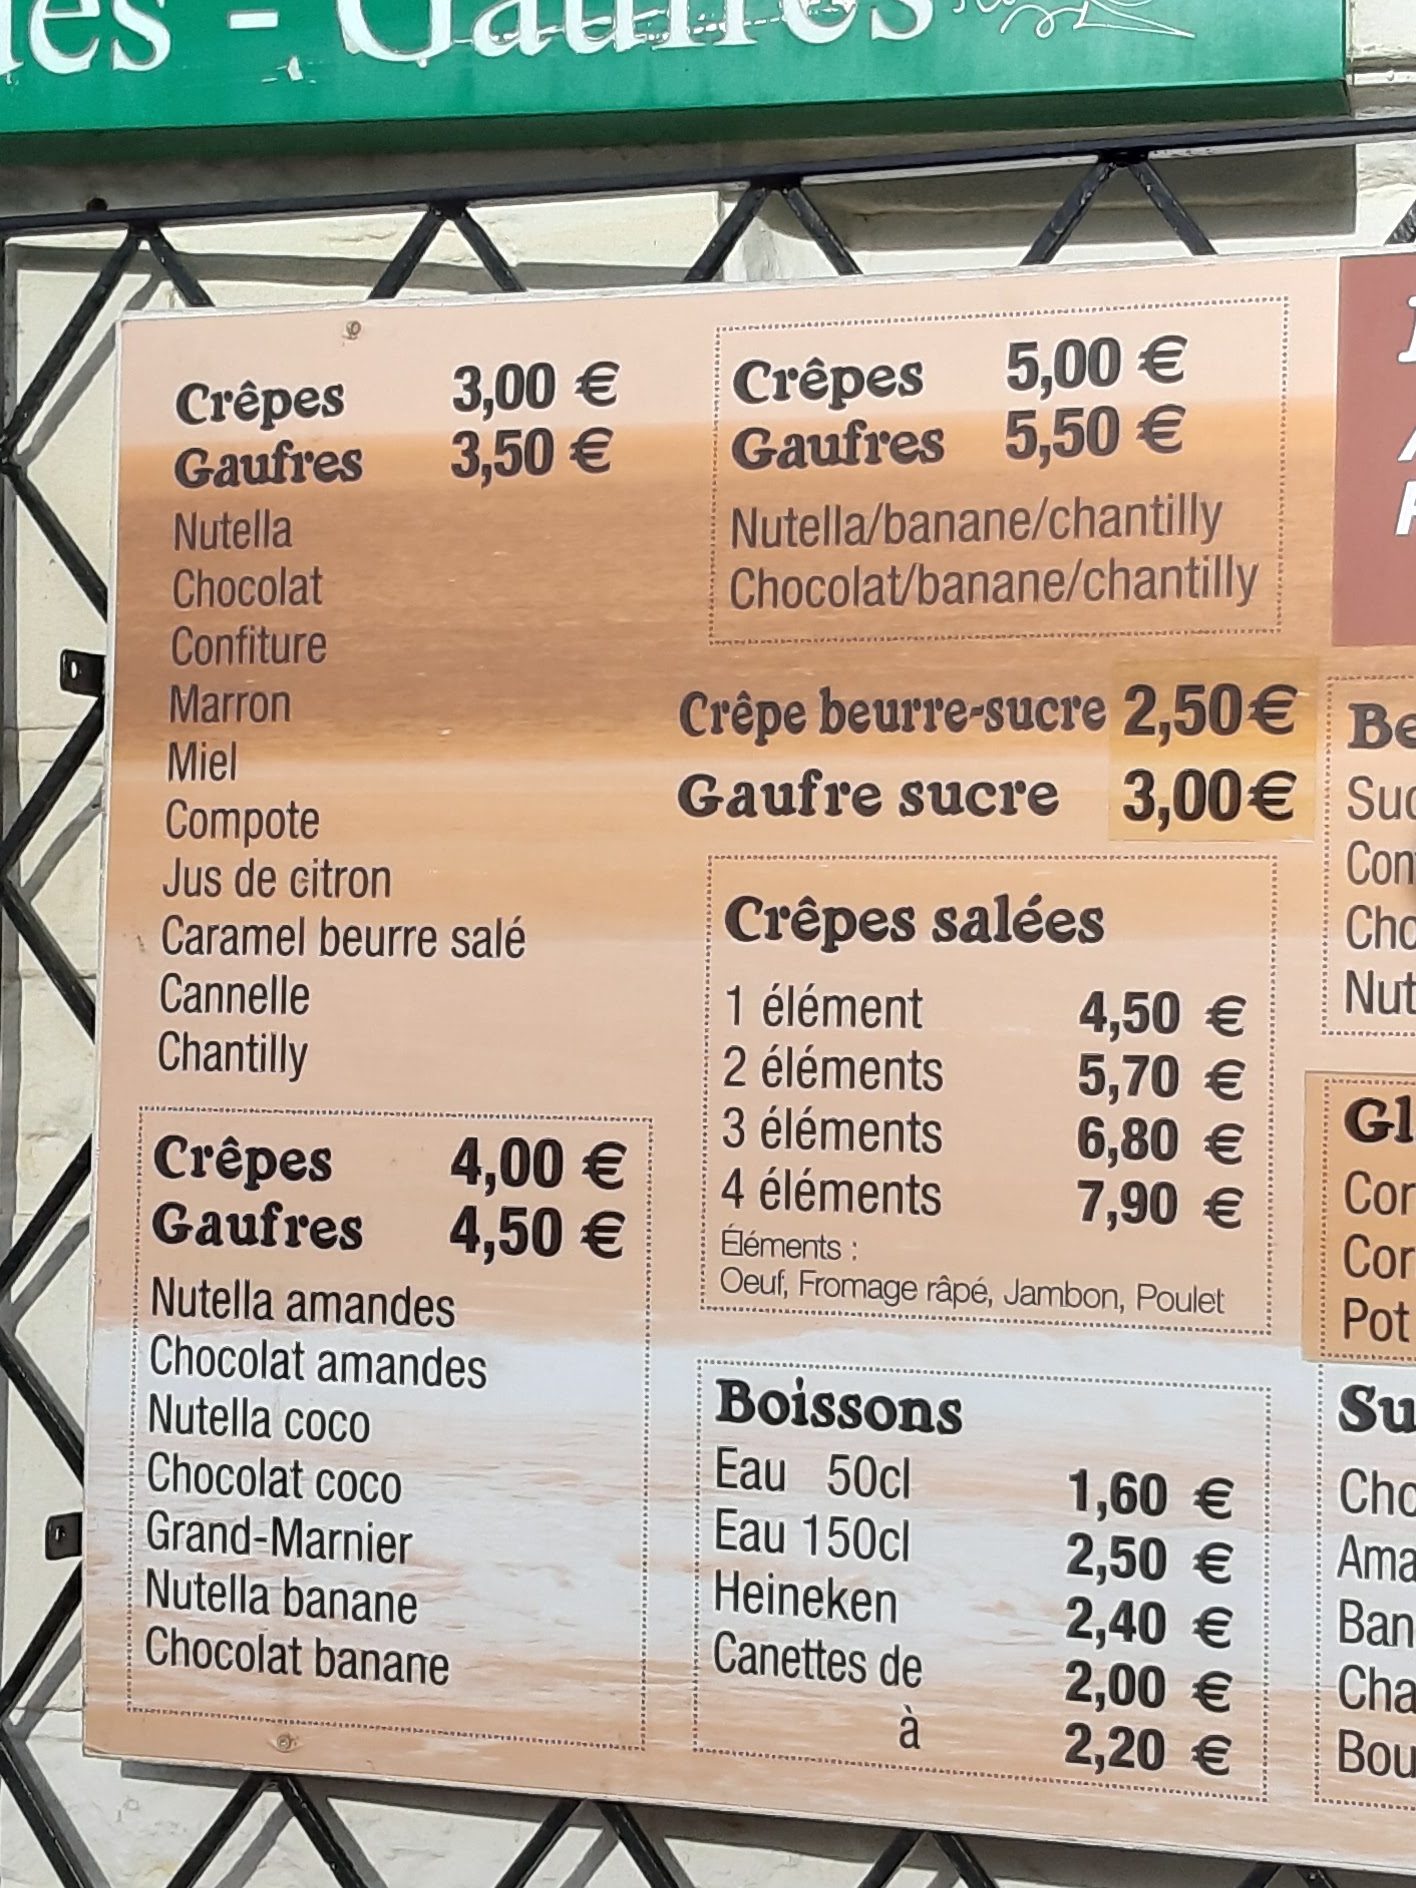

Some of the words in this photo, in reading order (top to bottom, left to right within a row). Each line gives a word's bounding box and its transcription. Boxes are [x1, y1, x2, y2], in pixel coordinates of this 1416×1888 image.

[175, 379, 345, 432] Crêpes
[732, 356, 924, 411] Crêpes
[174, 439, 363, 489] Gaufres
[731, 418, 945, 471] Gaufres
[174, 508, 293, 552] Nutella
[173, 565, 324, 609] Chocolat
[171, 624, 327, 667] Confiture
[169, 683, 291, 724] Marron
[679, 689, 807, 747] Crêpe
[818, 685, 1107, 735] beurre-sucre
[168, 741, 237, 783] Miel
[677, 767, 883, 819] Gaufre
[898, 779, 1060, 818] sucre
[166, 798, 320, 849] Compote
[162, 856, 222, 898] Jus
[234, 857, 277, 899] de
[290, 857, 391, 899] citron
[162, 914, 305, 957] Caramel
[318, 915, 437, 958] beurre
[450, 915, 526, 959] salé
[724, 895, 916, 954] Crêpes
[931, 892, 1105, 945] salées
[160, 972, 310, 1016] Cannelle
[726, 984, 741, 1026] 1
[762, 982, 924, 1029] élément
[158, 1030, 309, 1083] Chantilly
[723, 1044, 747, 1087] 2
[761, 1043, 944, 1092] éléments
[722, 1106, 745, 1149] 3
[760, 1104, 943, 1154] éléments
[153, 1134, 332, 1192] Crêpes
[721, 1167, 745, 1210] 4
[759, 1165, 942, 1217] éléments
[151, 1200, 363, 1251] Gaufres
[721, 1222, 842, 1261] Éléments
[151, 1276, 275, 1321] Nutella
[286, 1285, 455, 1329] amandes
[720, 1266, 788, 1300] Oeuf,
[799, 1270, 918, 1306] Fromage
[926, 1274, 993, 1310] râpé,
[1003, 1277, 1125, 1315] Jambon,
[1136, 1282, 1225, 1315] Poulet
[1343, 1297, 1410, 1344] Pot
[150, 1333, 306, 1381] Chocolat
[317, 1345, 487, 1390] amandes
[149, 1392, 272, 1439] Nutella
[284, 1407, 370, 1444] coco
[715, 1376, 963, 1435] Boissons
[147, 1451, 304, 1500] Chocolat
[315, 1468, 402, 1505] coco
[716, 1445, 786, 1492] Eau
[827, 1453, 910, 1500] 50cl
[146, 1509, 414, 1565] Grand-Marnier
[715, 1507, 785, 1554] Eau
[802, 1513, 910, 1562] 150cl
[146, 1567, 271, 1616] Nutella
[283, 1576, 418, 1625] banane
[715, 1568, 897, 1624] Heineken
[145, 1625, 303, 1677] Chocolat
[315, 1636, 450, 1686] banane
[713, 1630, 867, 1684] Canettes
[879, 1643, 923, 1689] de
[899, 1703, 921, 1750] à
